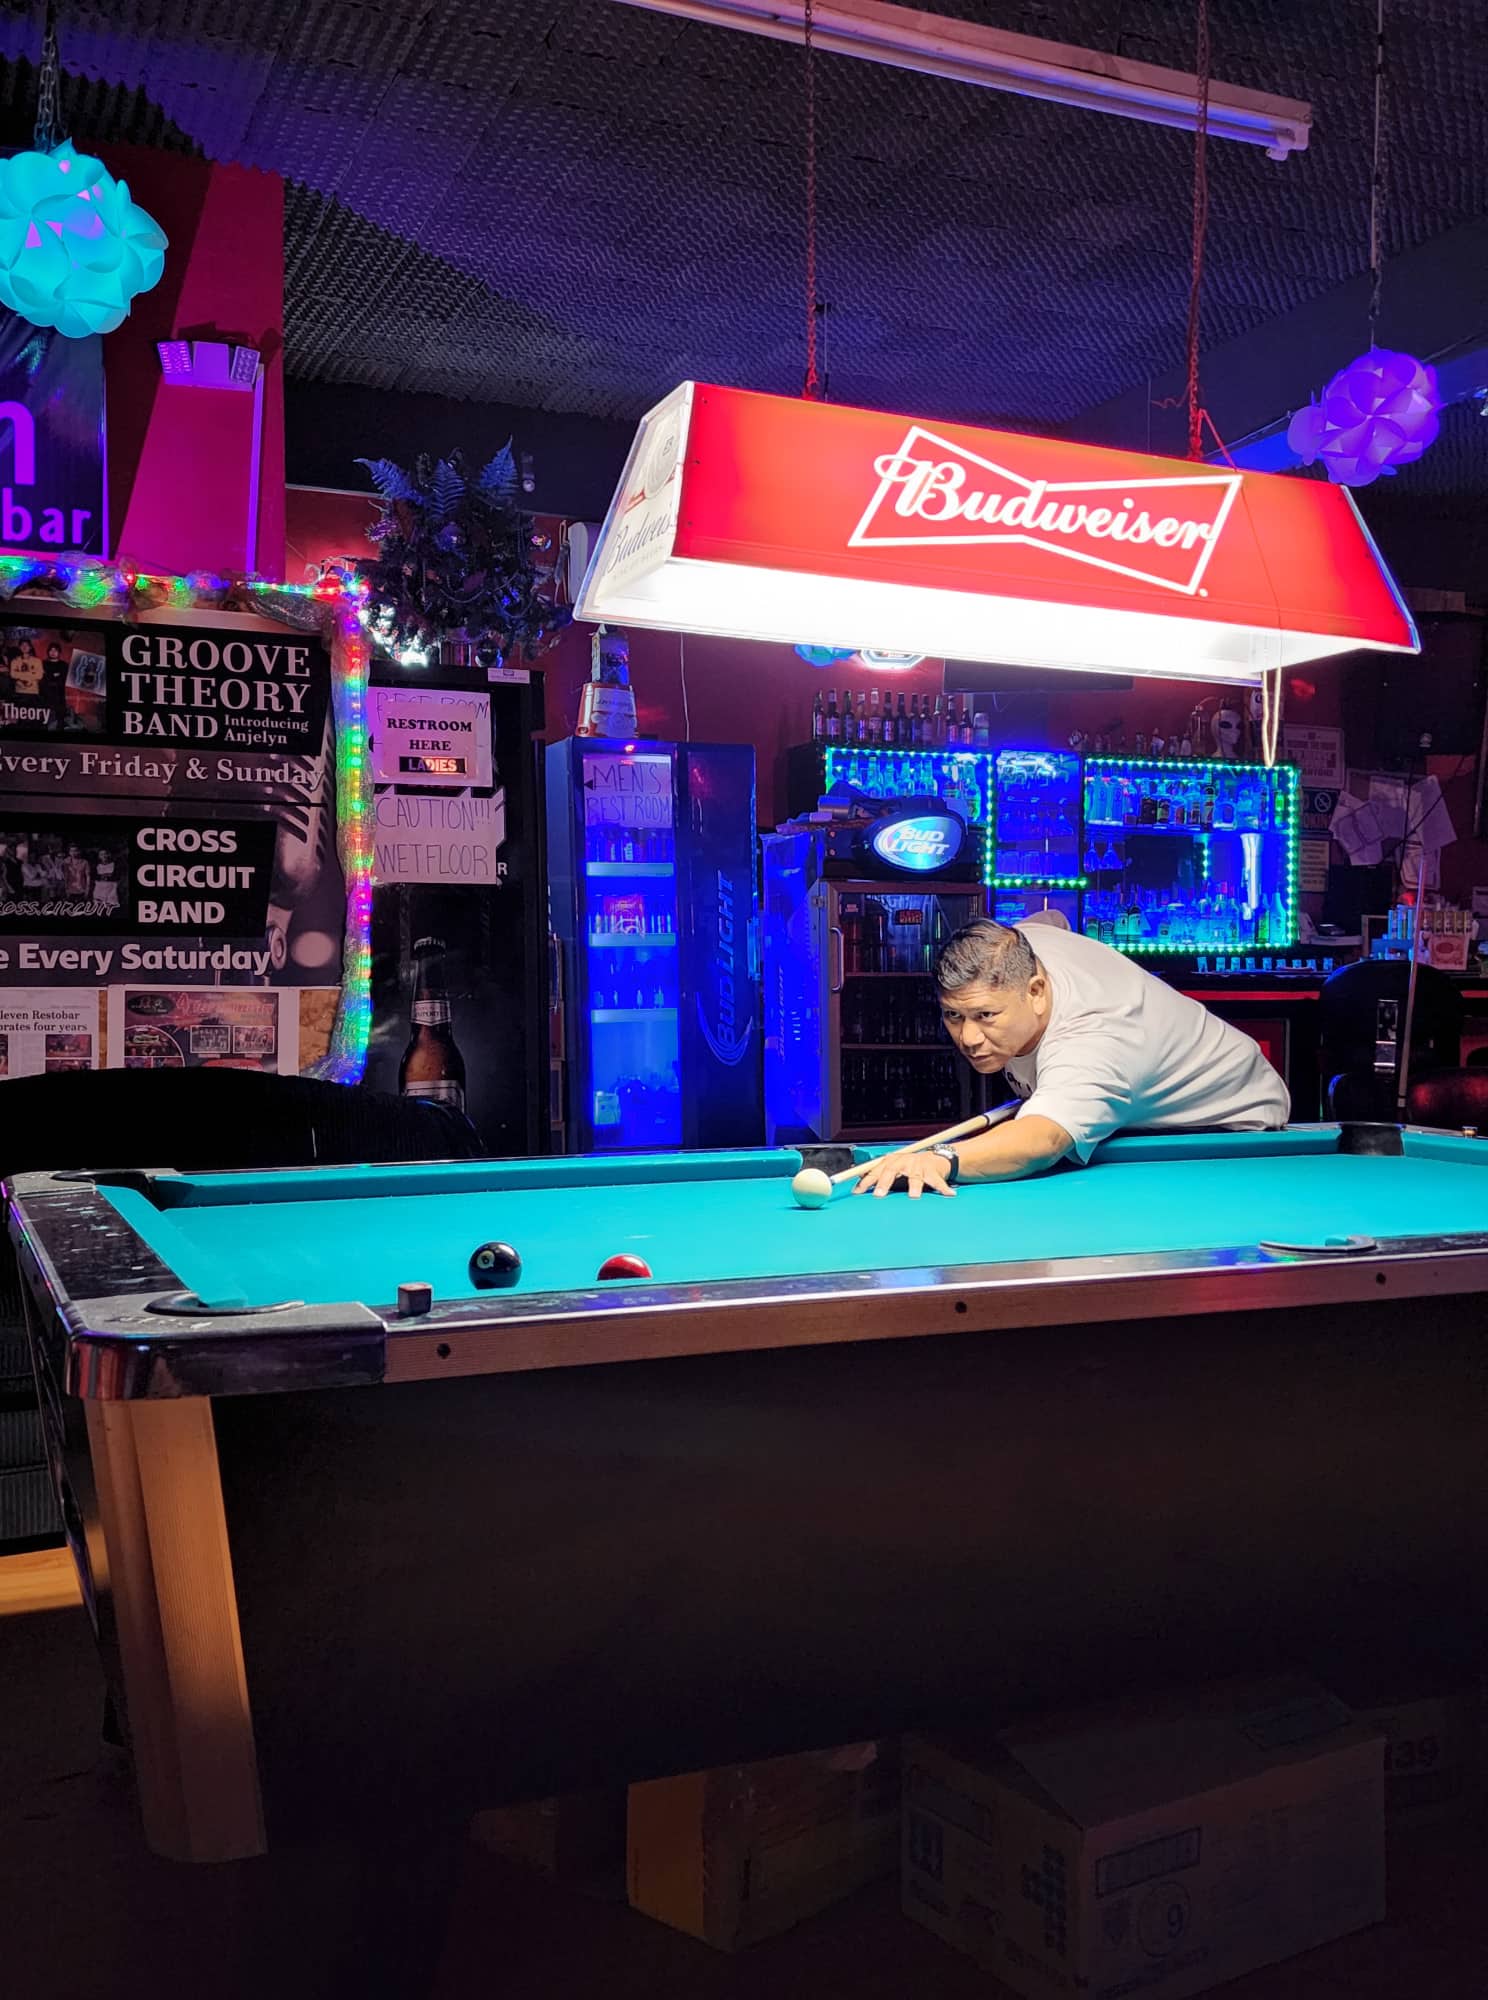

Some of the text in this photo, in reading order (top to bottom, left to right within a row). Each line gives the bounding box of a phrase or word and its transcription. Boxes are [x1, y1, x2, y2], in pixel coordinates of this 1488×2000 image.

[873, 454, 1212, 549] Budweiser
[121, 634, 310, 677] GROOVE
[121, 672, 311, 713] THEORY
[2, 703, 50, 724] Theory
[122, 711, 218, 738] BAND
[224, 714, 309, 733] Introducing
[387, 718, 472, 732] RESTROOM
[224, 728, 287, 747] Anjelyn
[409, 739, 452, 751] HERE
[0, 750, 324, 790] very Friday & Sunday
[408, 758, 457, 772] LADIES
[376, 797, 492, 831] CAUTION!!!
[136, 827, 238, 853] CROSS
[900, 829, 945, 841] BUD
[889, 841, 950, 855] LIGHT
[136, 864, 255, 889] CIRCUIT
[137, 900, 225, 924] BAND
[19, 943, 113, 975] Every
[121, 943, 271, 975] Saturday
[32, 1010, 80, 1020] Restobar
[33, 1022, 56, 1031] four
[58, 1023, 88, 1033] years
